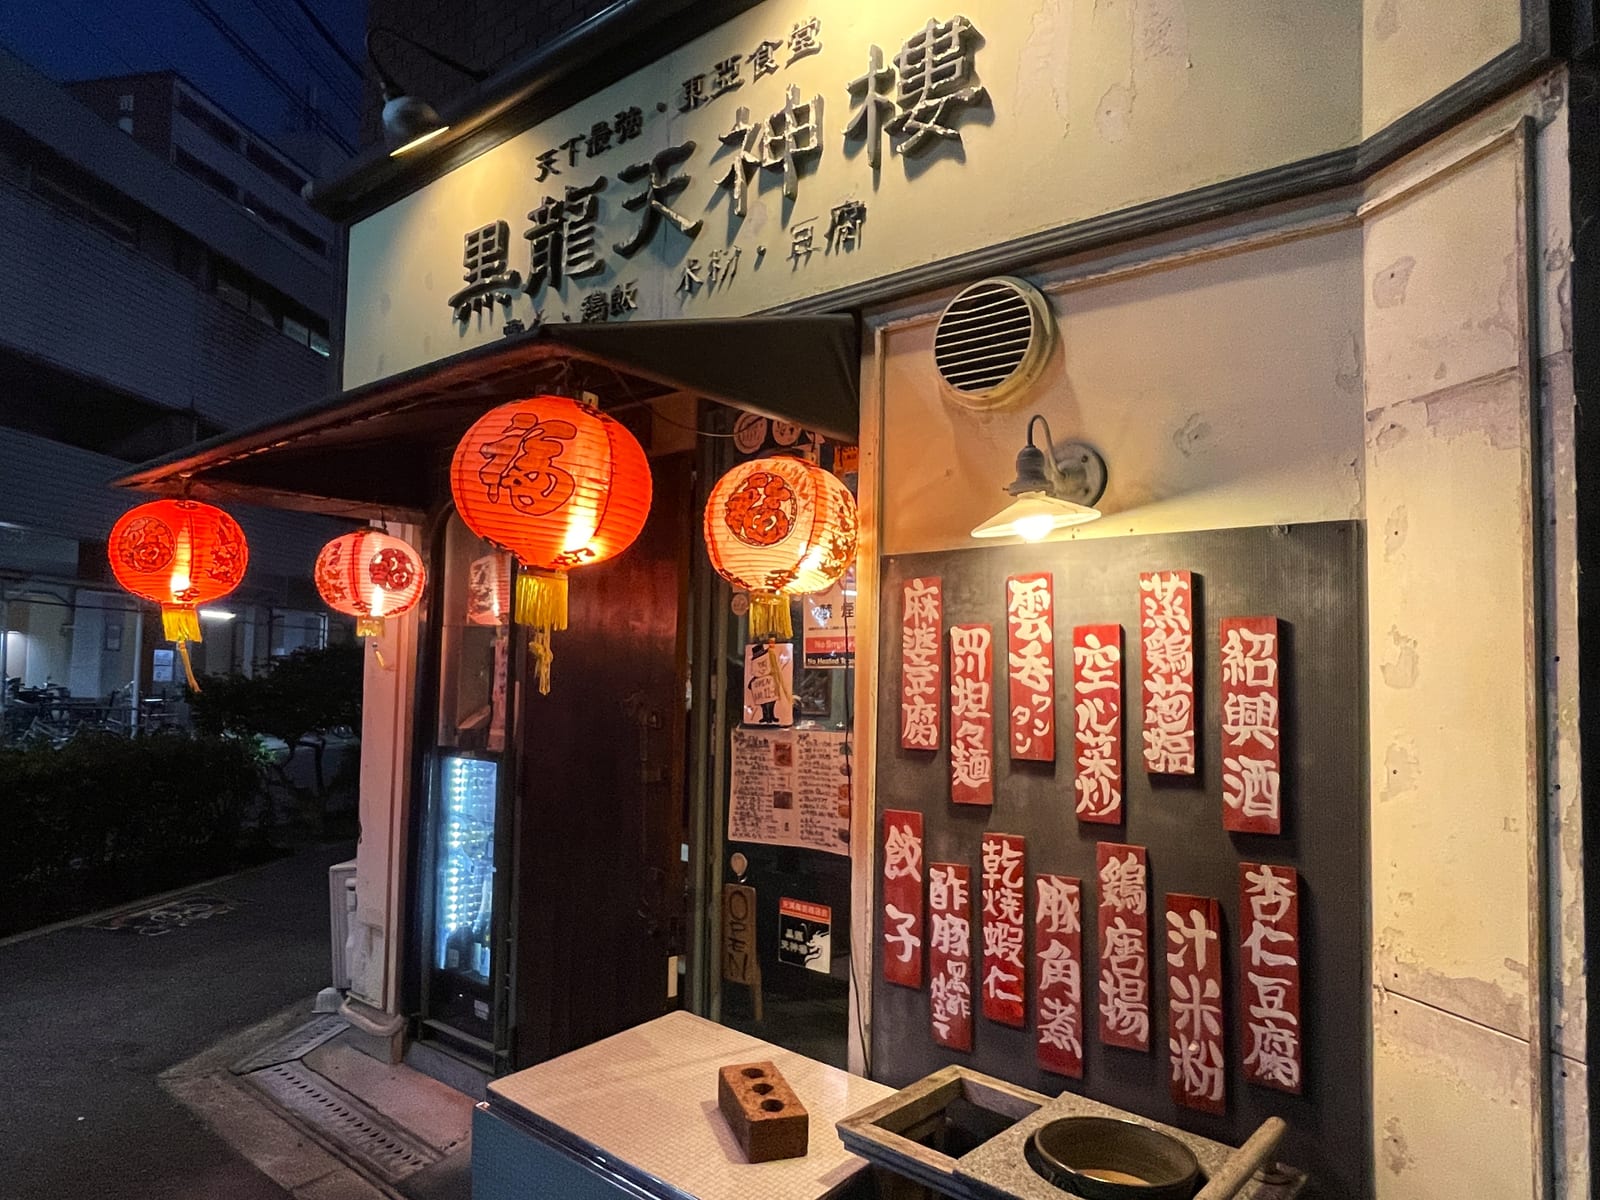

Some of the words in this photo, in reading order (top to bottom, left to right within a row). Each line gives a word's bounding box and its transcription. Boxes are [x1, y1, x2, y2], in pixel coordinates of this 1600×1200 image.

[902, 577, 940, 747] 麻婆豆腐
[1008, 579, 1053, 692] 雲呑
[1074, 633, 1121, 816] 空心菜炒
[1222, 628, 1279, 819] 紹興酒
[884, 824, 921, 963] 餃子
[929, 866, 970, 957] 酢豚
[1036, 875, 1082, 1060] 豚角煮
[1099, 852, 1150, 1043] 鶏唐揚
[1241, 864, 1300, 1089] 杏仁豆腐
[1166, 909, 1225, 1101] 汁米粉
